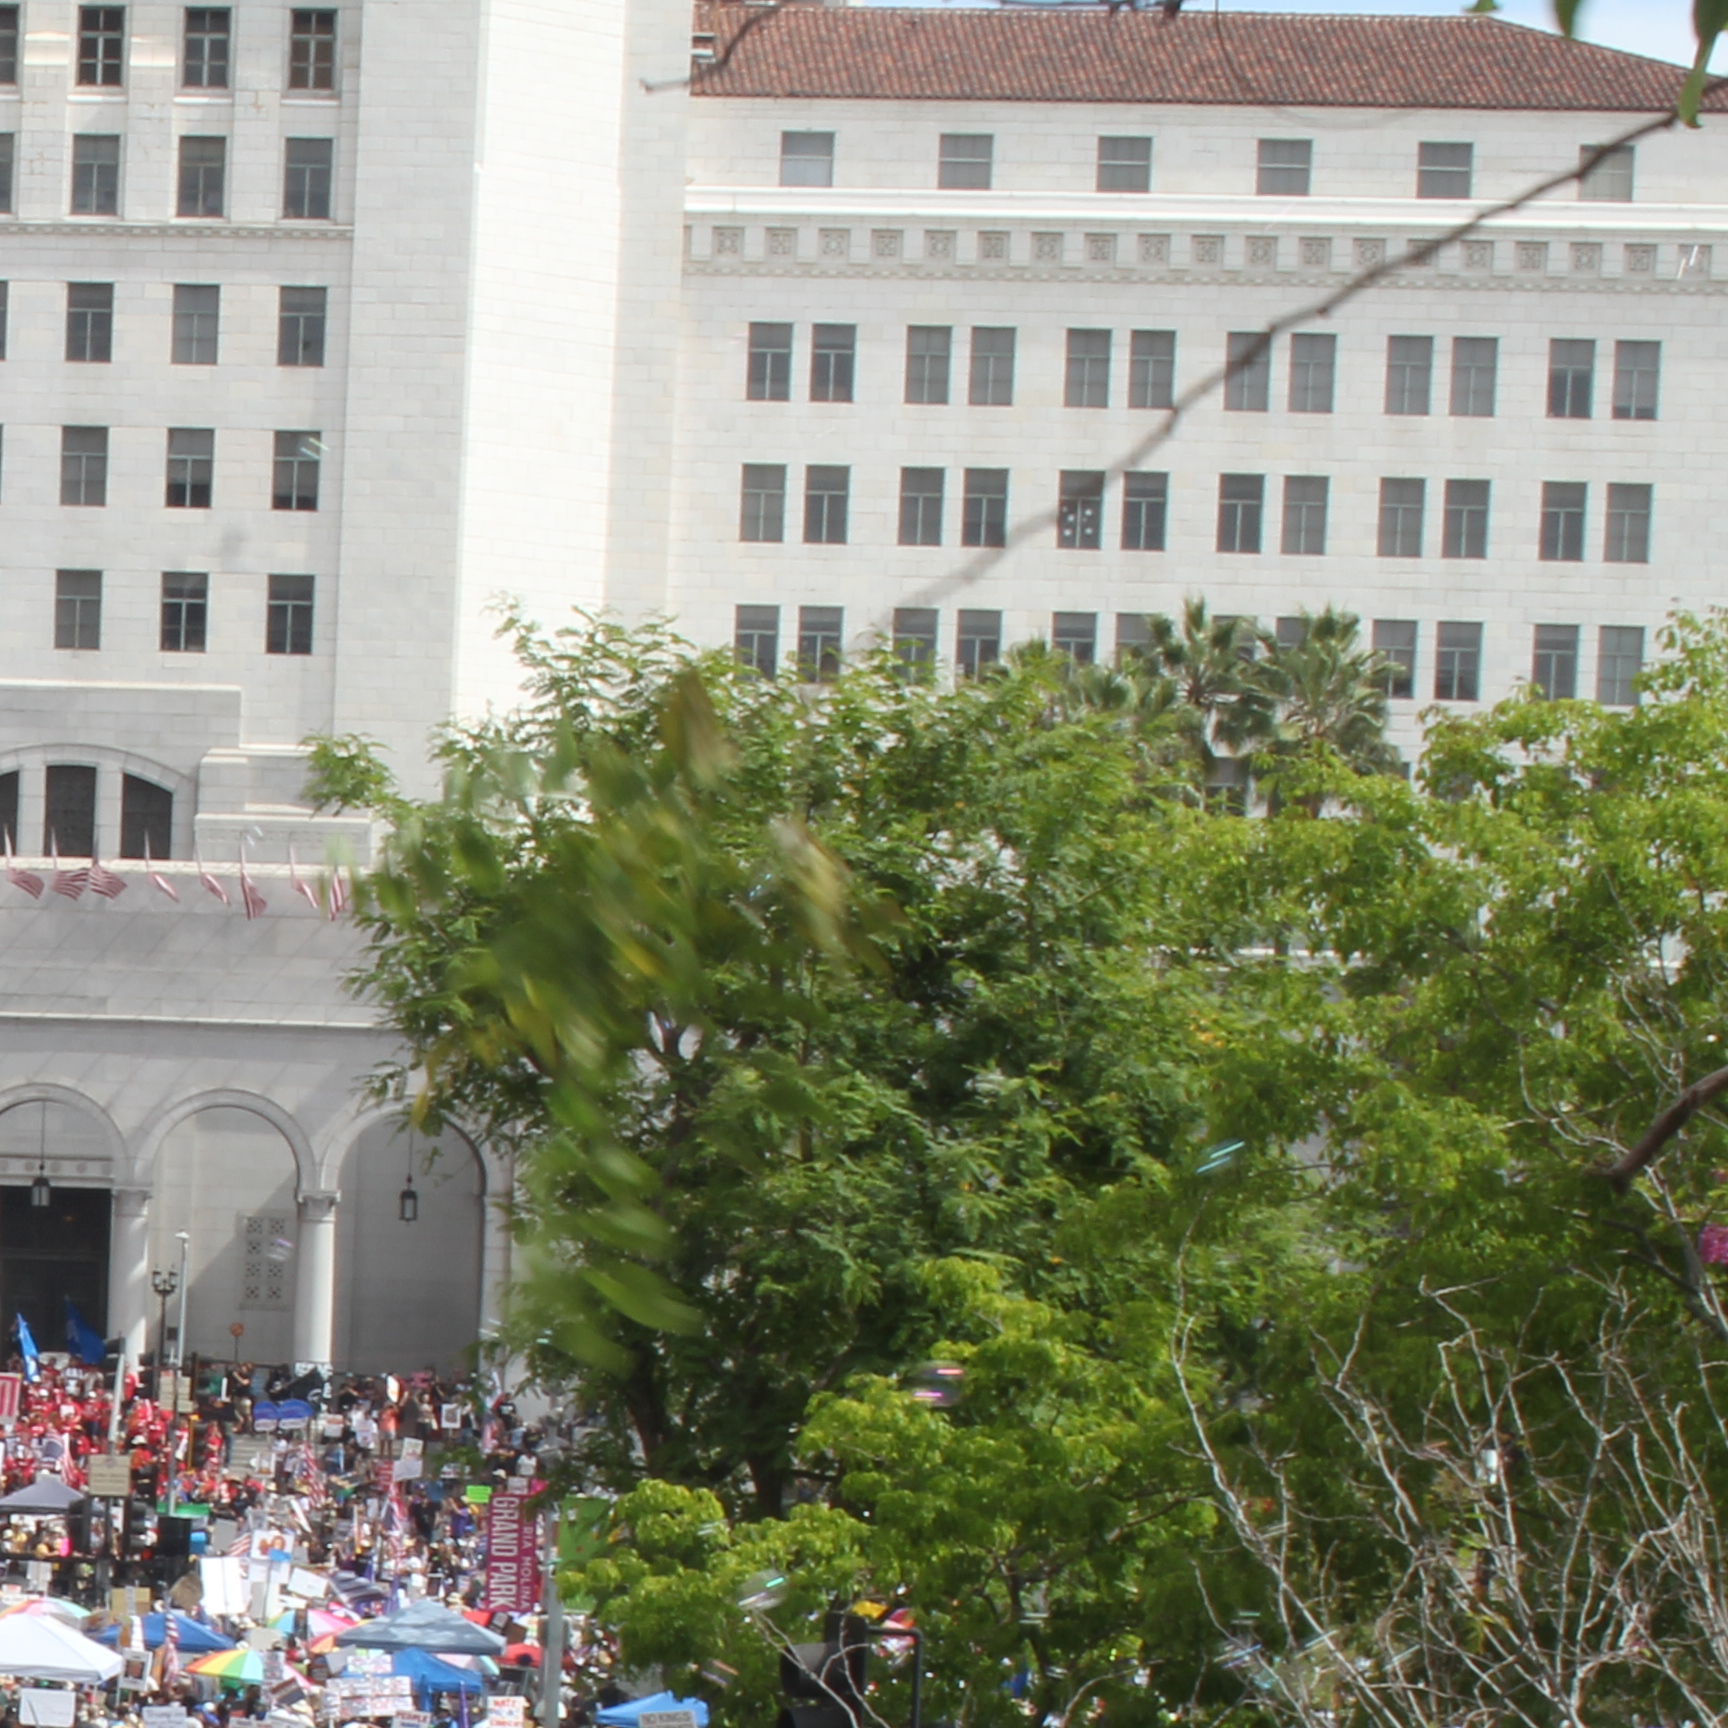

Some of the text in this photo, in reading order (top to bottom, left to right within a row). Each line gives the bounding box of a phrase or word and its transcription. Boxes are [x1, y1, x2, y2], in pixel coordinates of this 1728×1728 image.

[489, 1497, 520, 1609] GRAND PARK
[520, 1526, 533, 1609] RIA MOLINA
